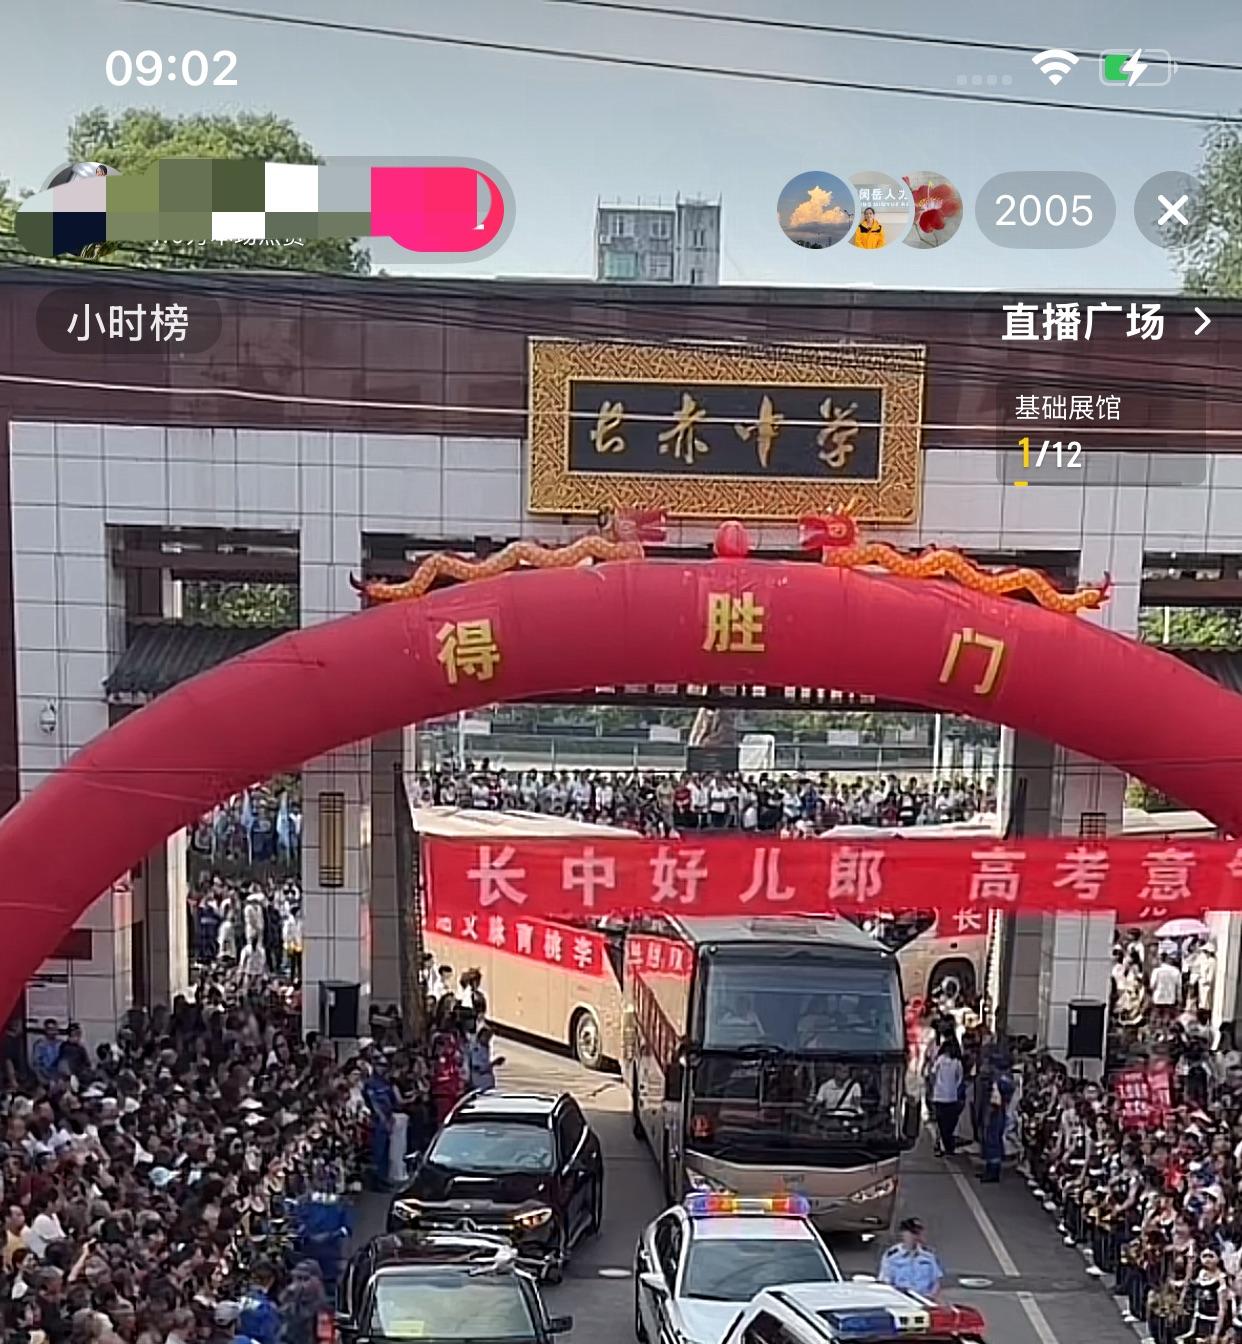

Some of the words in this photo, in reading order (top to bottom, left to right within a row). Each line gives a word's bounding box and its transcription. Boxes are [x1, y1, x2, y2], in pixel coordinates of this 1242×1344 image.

[589, 390, 859, 468] 长赤中学
[435, 591, 1005, 696] 得胜门
[466, 845, 887, 908] 长中好儿郎
